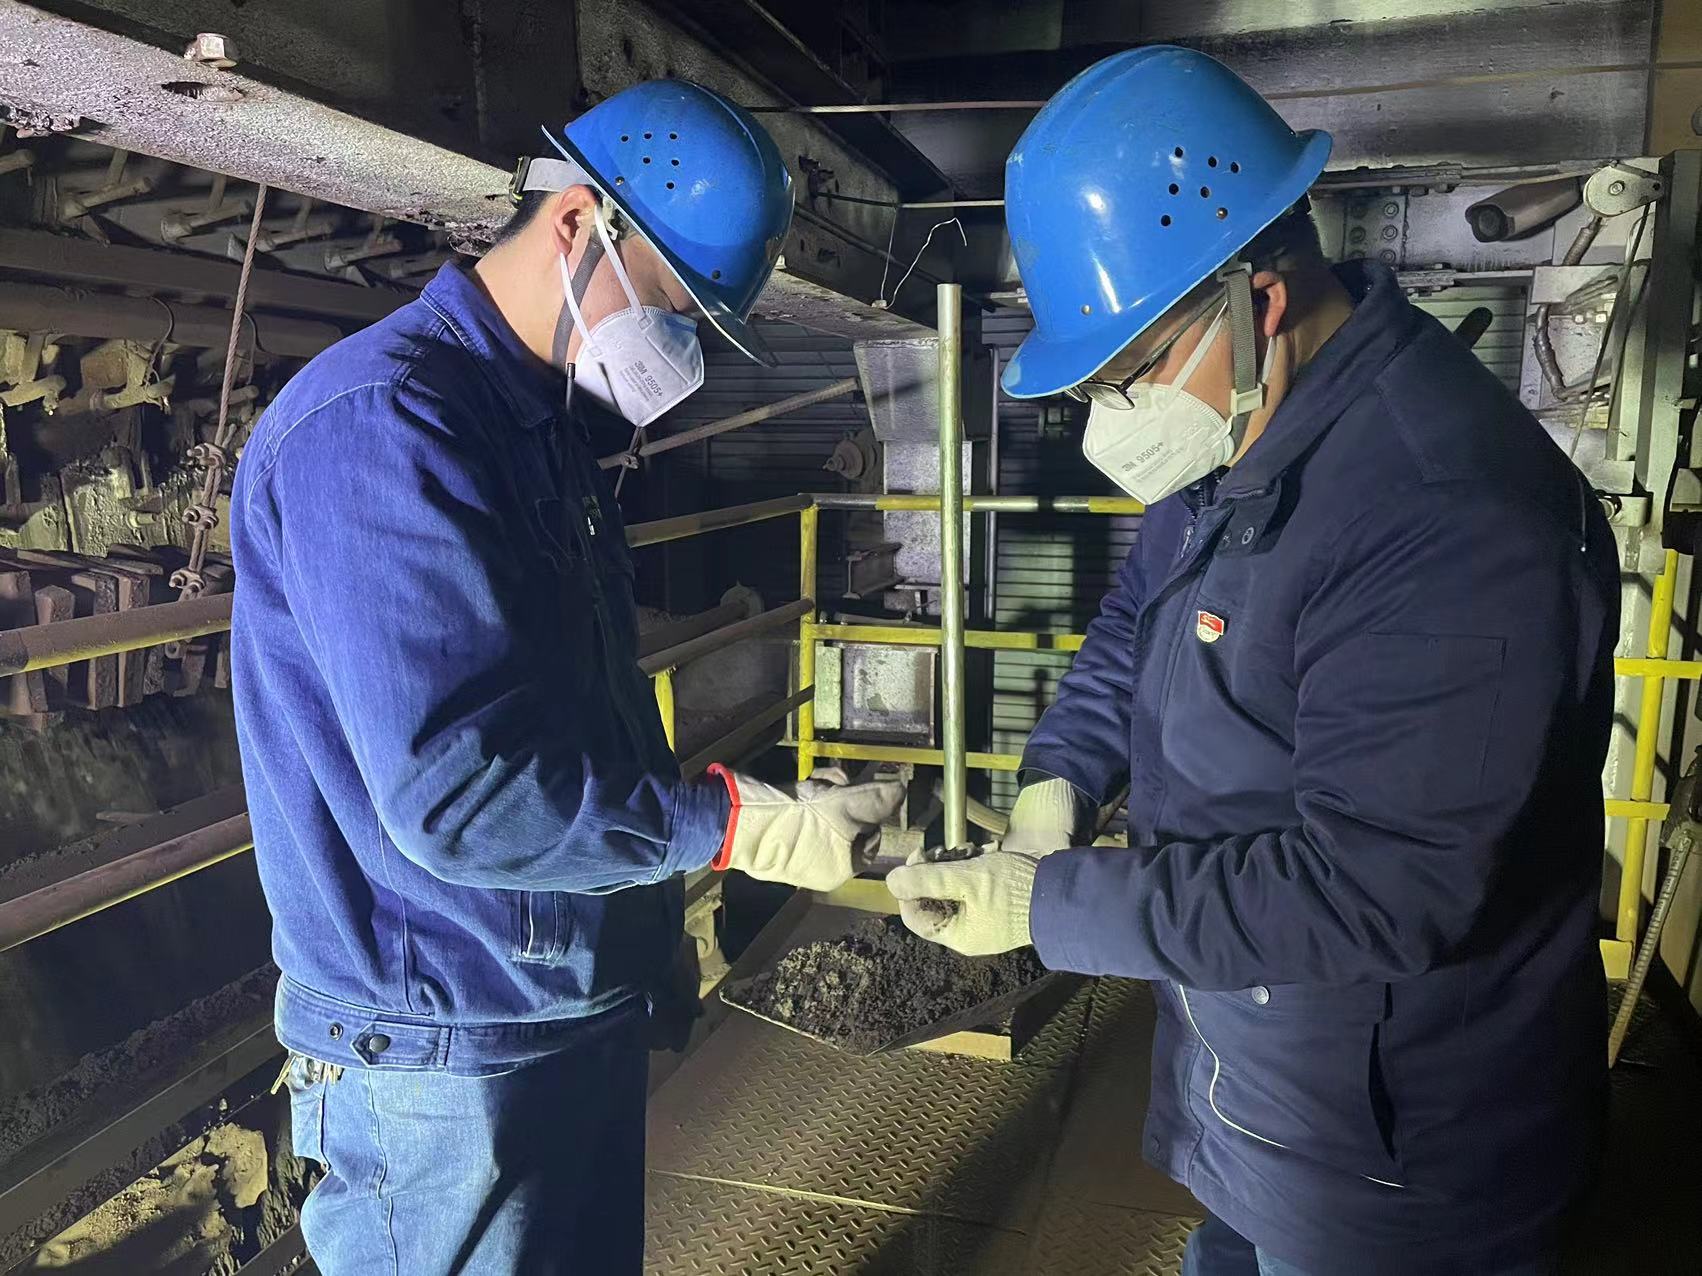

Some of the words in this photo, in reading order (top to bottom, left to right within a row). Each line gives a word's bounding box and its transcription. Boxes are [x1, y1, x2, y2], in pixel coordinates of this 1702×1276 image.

[635, 361, 647, 375] 3M
[645, 375, 664, 396] 9505+
[1121, 461, 1136, 472] 3M
[1136, 441, 1164, 463] 9505+
